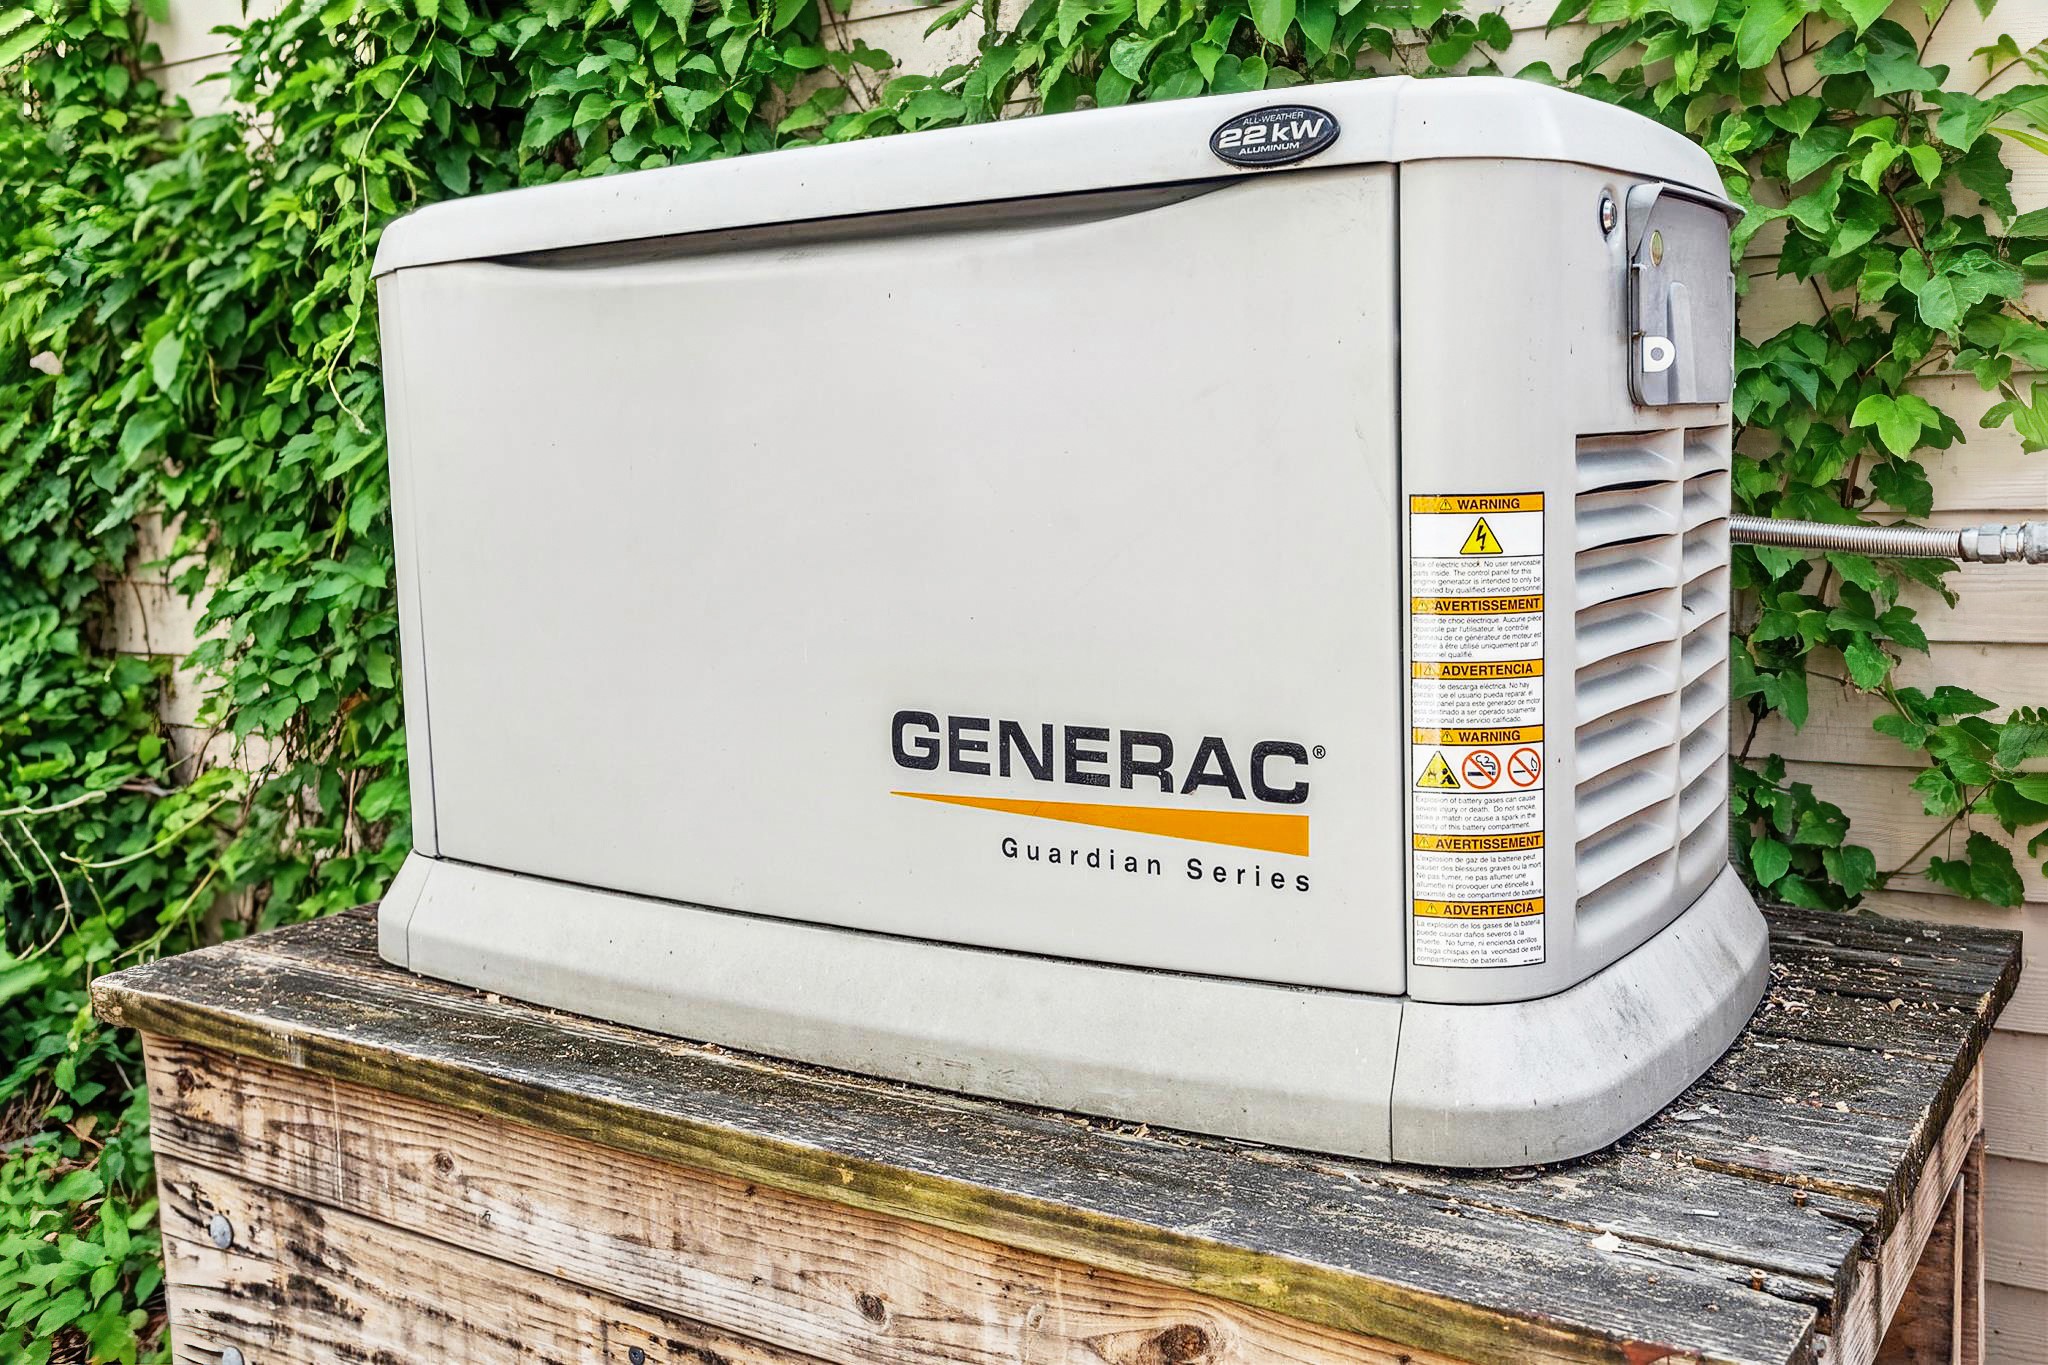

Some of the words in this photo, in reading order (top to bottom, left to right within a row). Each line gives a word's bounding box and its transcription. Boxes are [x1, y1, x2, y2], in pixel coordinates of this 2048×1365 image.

[1242, 111, 1304, 126] ALL-WEATHER
[1218, 124, 1267, 149] 22
[1271, 118, 1325, 142] kW
[1238, 142, 1300, 155] ALUMINUM
[1457, 498, 1520, 510] WARNING
[1435, 598, 1540, 611] AVERTISSEMENT
[1442, 663, 1533, 676] ADVERTENCIA
[1458, 730, 1521, 742] WARNING
[1436, 835, 1541, 849] AVERTISSEMENT
[1001, 836, 1162, 877] Guardian
[1186, 857, 1311, 893] Series
[1443, 902, 1534, 915] ADVERTENCIA
